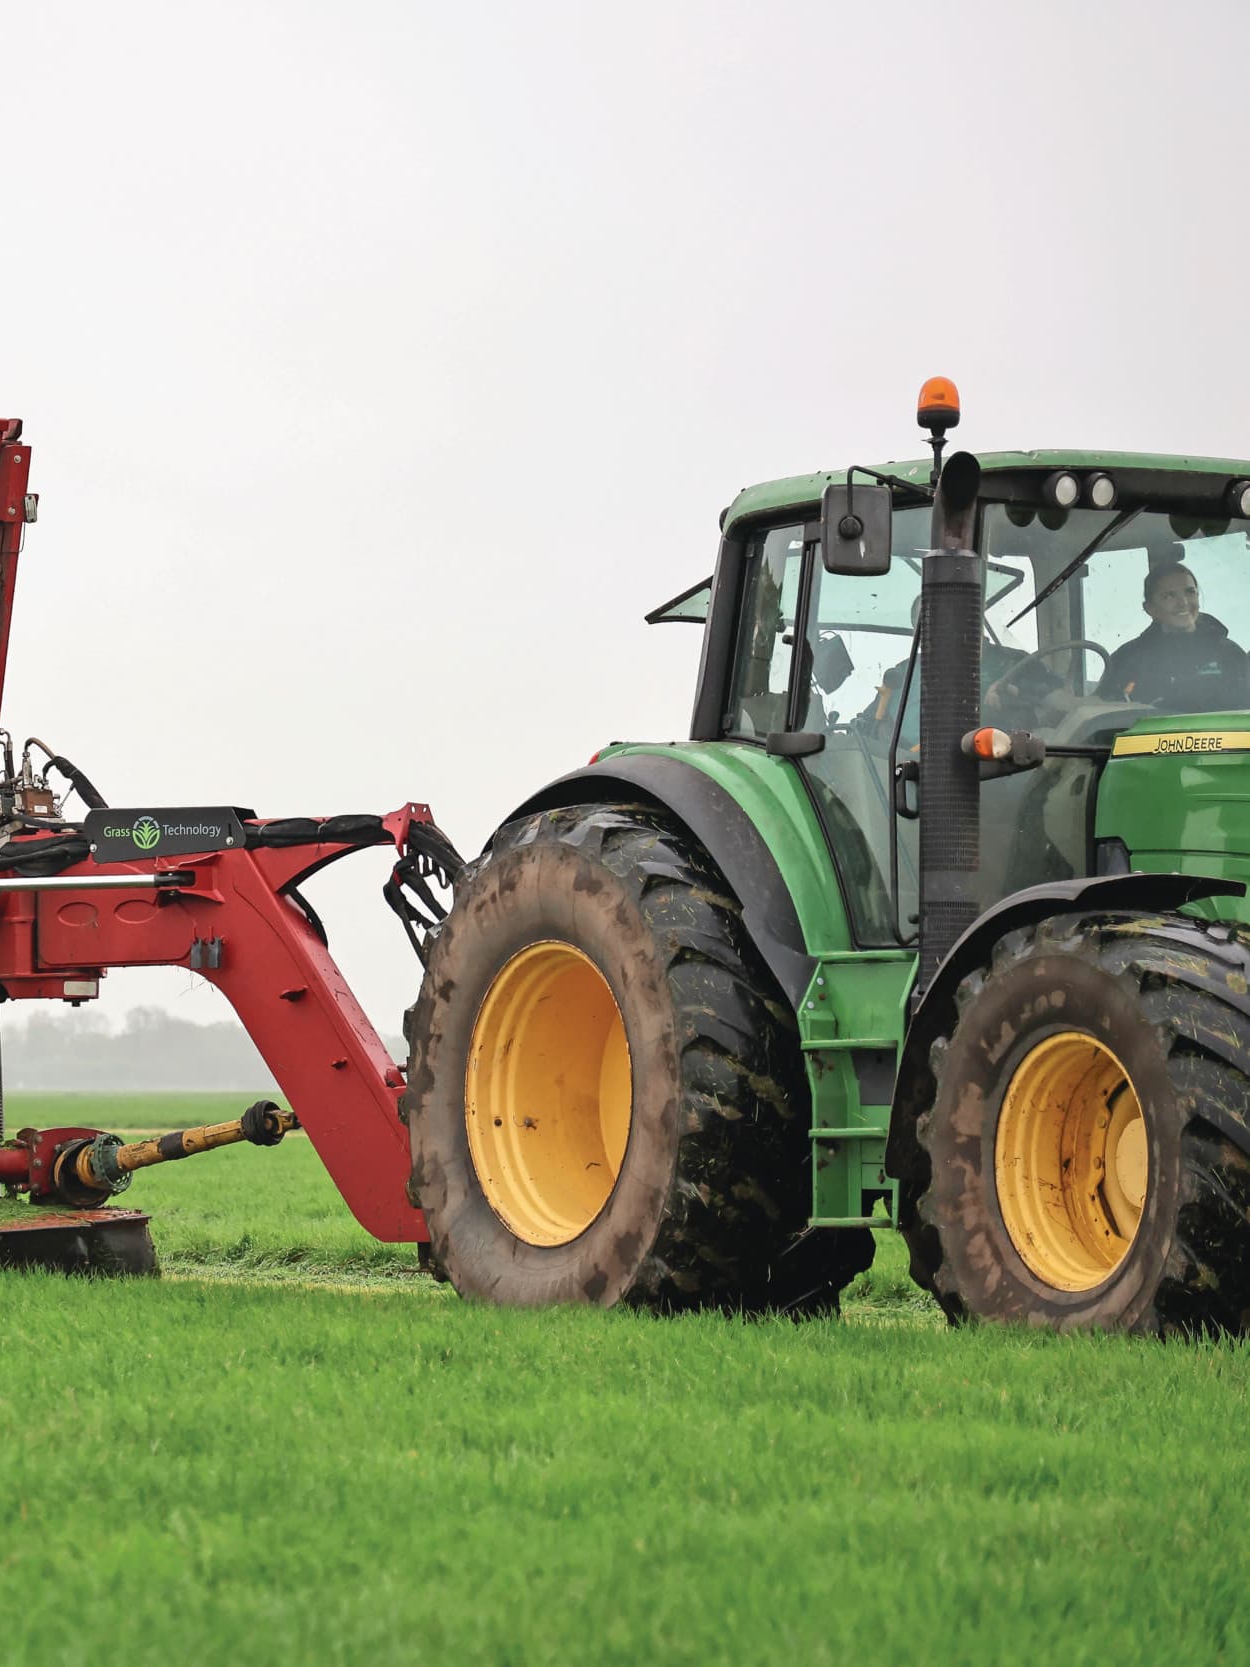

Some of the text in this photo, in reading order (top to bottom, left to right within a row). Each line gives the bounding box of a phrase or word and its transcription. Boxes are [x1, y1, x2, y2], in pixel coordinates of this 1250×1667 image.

[1154, 736, 1223, 752] JOHN DEERE
[103, 823, 222, 838] Grass Technology
